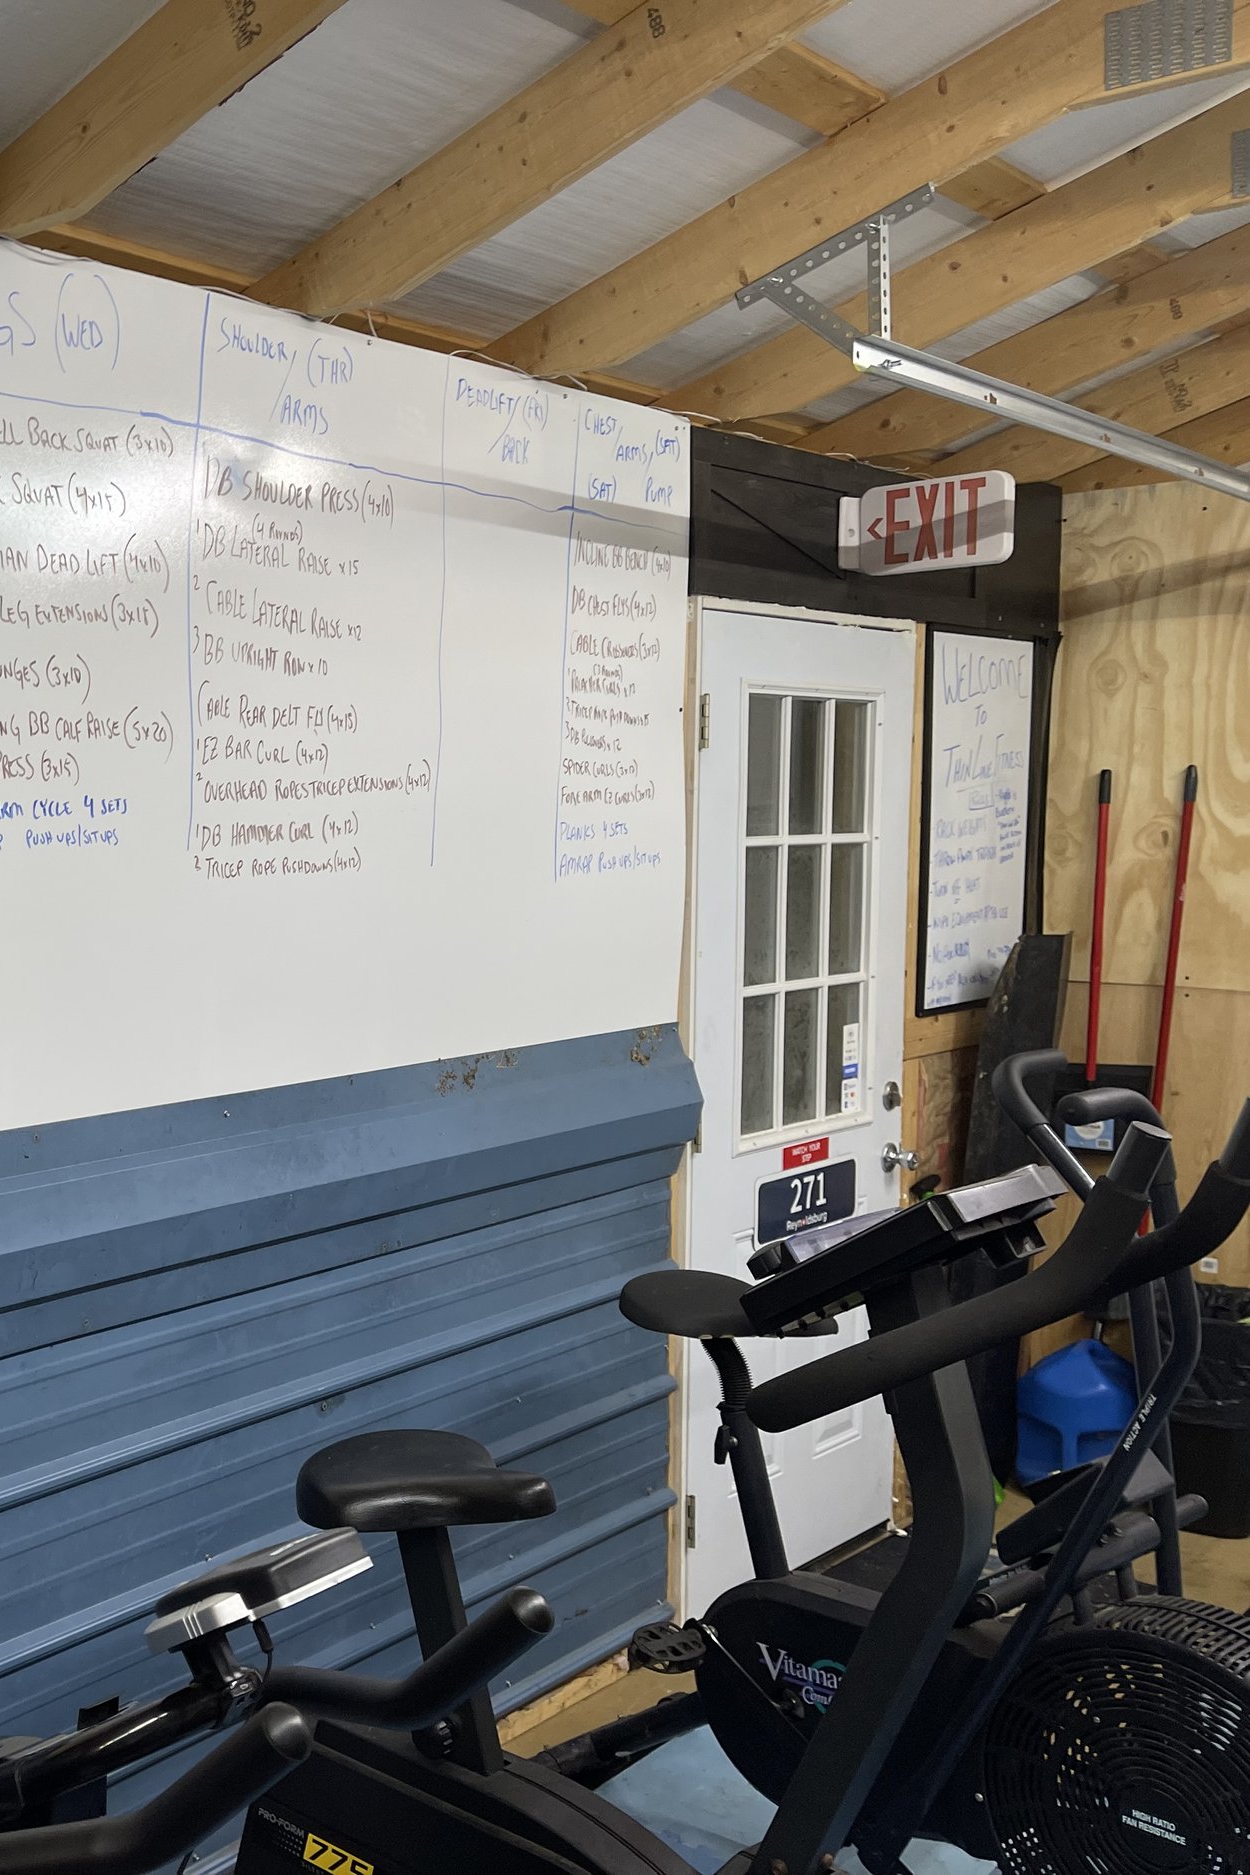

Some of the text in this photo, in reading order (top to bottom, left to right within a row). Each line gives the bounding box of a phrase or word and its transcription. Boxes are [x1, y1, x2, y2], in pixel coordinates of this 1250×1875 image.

[55, 273, 120, 374] (WED)
[307, 338, 354, 388] (THR)
[27, 416, 73, 451] BACK
[73, 428, 119, 452] SQUAT
[11, 472, 64, 507] SQUAT
[205, 455, 233, 499] DB
[242, 470, 314, 511] SHOULDER
[321, 481, 359, 514] PRESS
[884, 476, 986, 565] EXIT
[202, 522, 332, 577] DB LATERAL RAISE
[0, 595, 31, 629] LEG
[206, 580, 247, 620] CABLE
[252, 587, 306, 635] LATERAL
[311, 607, 343, 639] RAISE
[204, 633, 224, 665] BB
[231, 641, 279, 672] UPRIGHT
[942, 642, 1028, 705] WELCOME
[29, 711, 50, 737] BB
[55, 717, 82, 743] CALF
[86, 711, 120, 740] RAISE
[239, 694, 267, 728] REAR
[272, 704, 301, 730] DELT
[975, 704, 987, 727] TO
[201, 735, 219, 765] EZ
[225, 734, 252, 760] BAR
[256, 739, 290, 765] CURL
[33, 799, 73, 820] CYCLE
[84, 795, 95, 818] 4
[101, 798, 128, 815] SETS
[203, 778, 268, 804] OVERHEAD
[201, 823, 222, 851] DB
[231, 821, 284, 847] HAMMER
[289, 821, 314, 843] CURL
[205, 858, 244, 880] TRICEP
[251, 857, 277, 877] ROPE
[790, 1172, 827, 1214] 271
[1123, 1394, 1157, 1451] TRIPLE ACTION
[756, 1641, 843, 1689] Vitama
[1122, 1815, 1186, 1846] FAN RESISTANCE
[1132, 1810, 1176, 1832] HIGH RATIO
